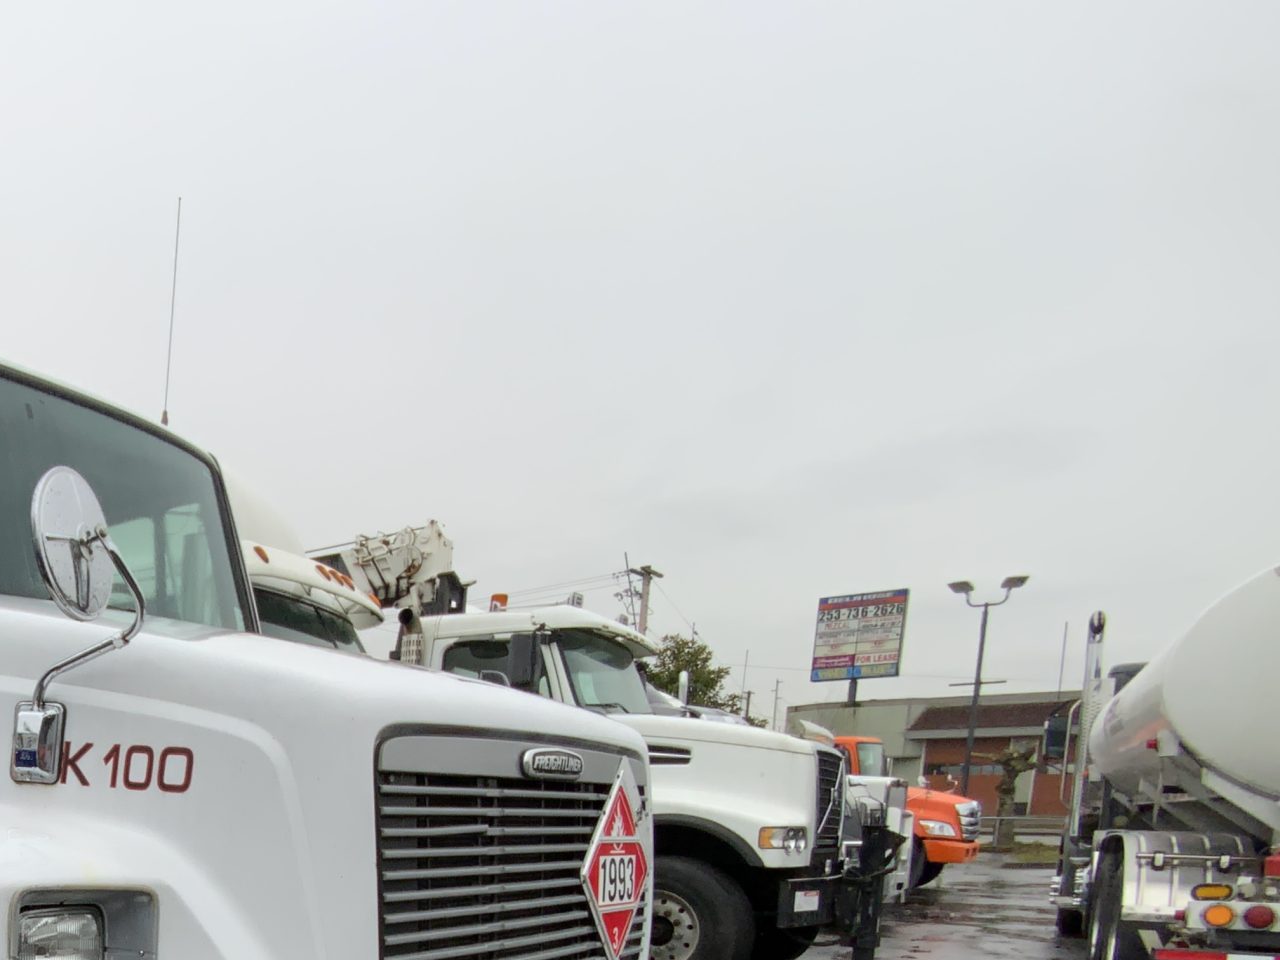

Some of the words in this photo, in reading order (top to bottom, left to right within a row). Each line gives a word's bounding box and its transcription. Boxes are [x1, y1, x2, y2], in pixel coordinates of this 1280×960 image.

[819, 603, 904, 622] 253-736-2626
[856, 655, 871, 663] FOR
[873, 653, 898, 662] LEASE
[533, 755, 581, 771] FREIGHTLINER
[600, 856, 634, 903] 1993
[612, 926, 619, 949] 3
